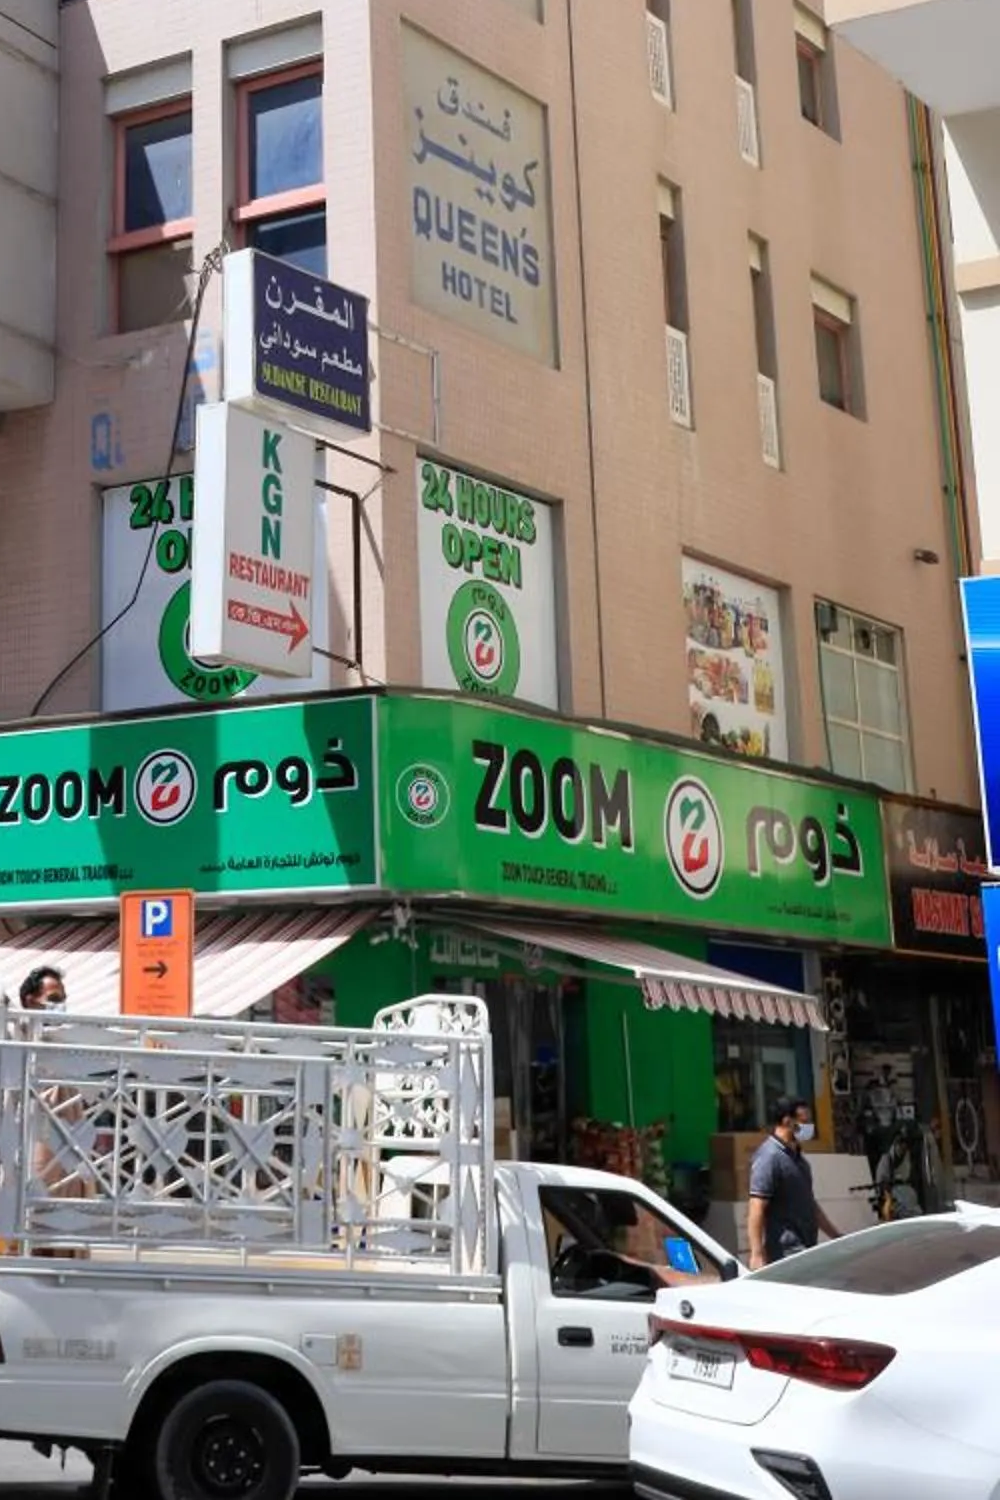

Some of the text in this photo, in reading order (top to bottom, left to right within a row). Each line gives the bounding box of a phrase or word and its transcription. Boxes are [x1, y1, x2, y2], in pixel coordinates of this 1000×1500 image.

[437, 76, 512, 142] فندق
[412, 106, 539, 212] كوينز
[413, 185, 541, 288] QUEEN'S
[265, 275, 354, 331] المقرن
[442, 260, 518, 324] HOTEL
[259, 321, 363, 377] مطعم سوداني
[309, 378, 362, 418] RESTAURANT
[129, 483, 175, 530] 24
[261, 428, 284, 561] KGN
[421, 462, 537, 545] 24 HOURS
[229, 552, 310, 600] RESTAURANT
[441, 522, 523, 590] OPEN
[179, 666, 242, 696] ZOOM
[472, 738, 636, 854] ZOOM
[43, 867, 80, 883] GENERAL
[145, 901, 169, 935] P
